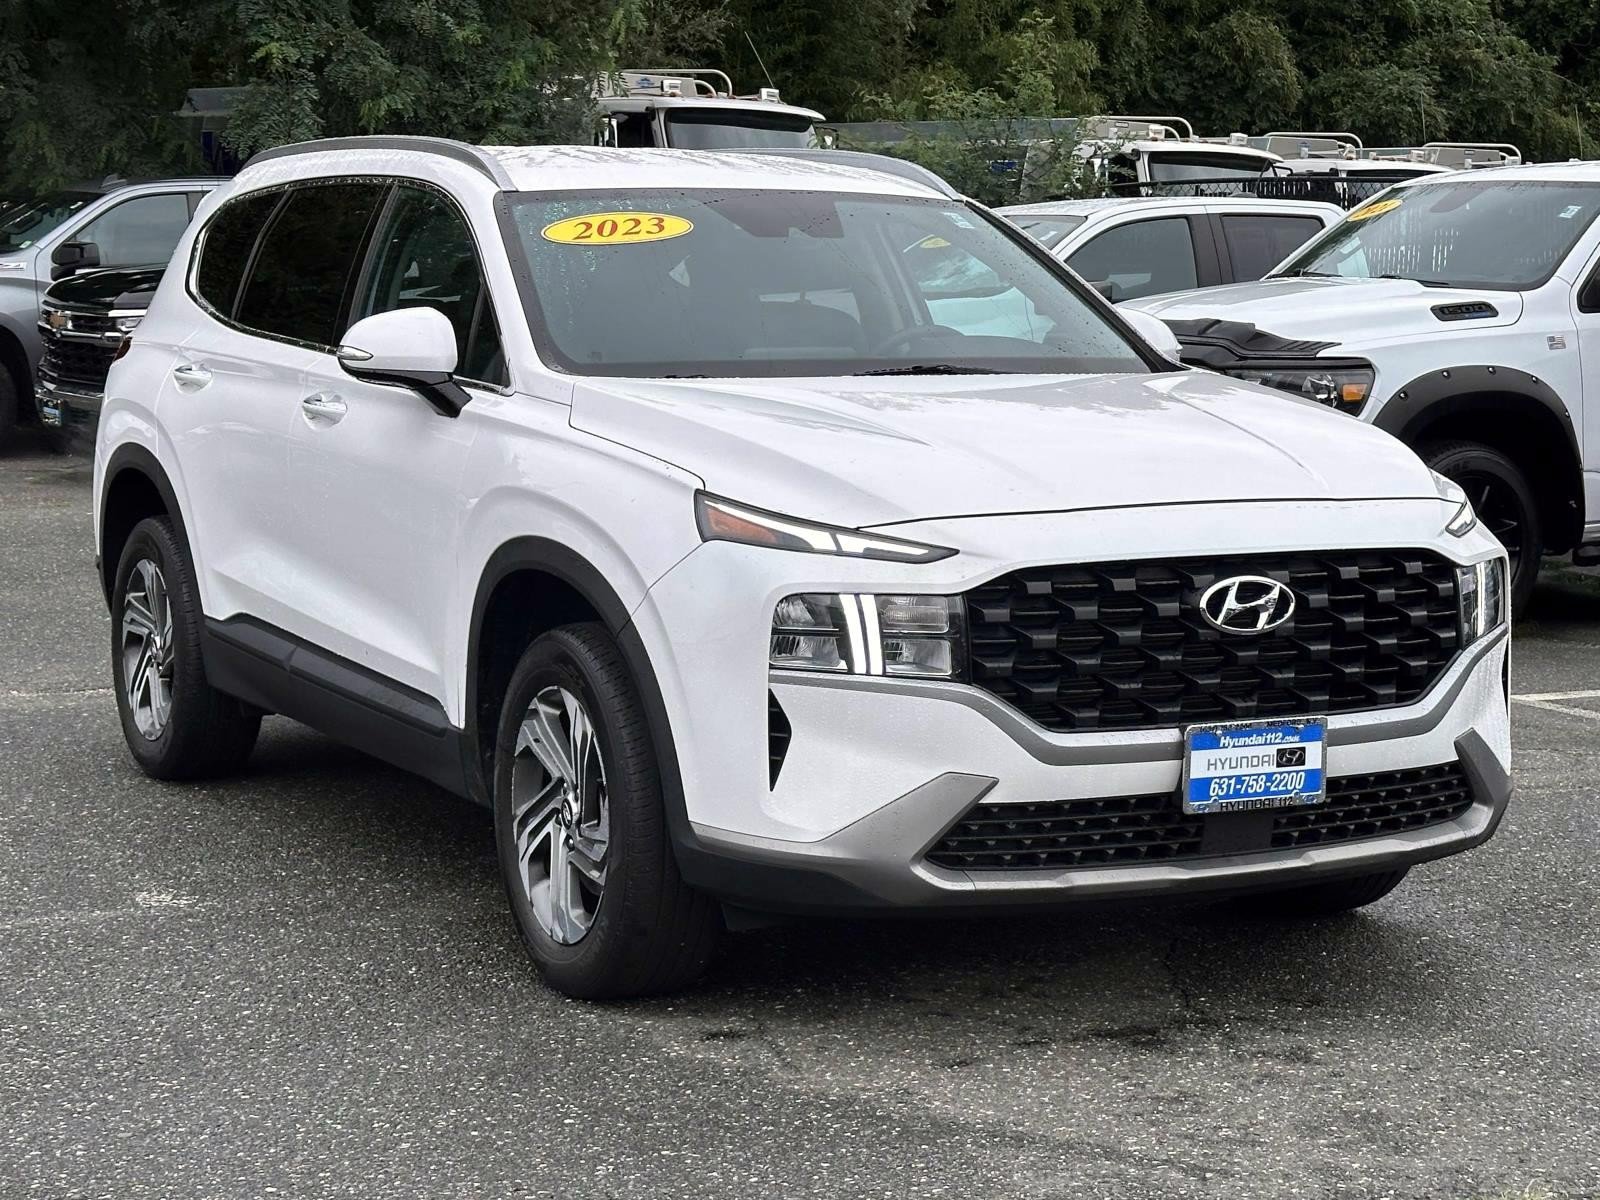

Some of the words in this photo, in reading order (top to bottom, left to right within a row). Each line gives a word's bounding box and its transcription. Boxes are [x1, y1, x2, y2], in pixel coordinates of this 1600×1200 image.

[572, 217, 665, 240] 2023
[1207, 754, 1275, 771] HYUNDAI
[1209, 772, 1305, 796] 631-758-2200
